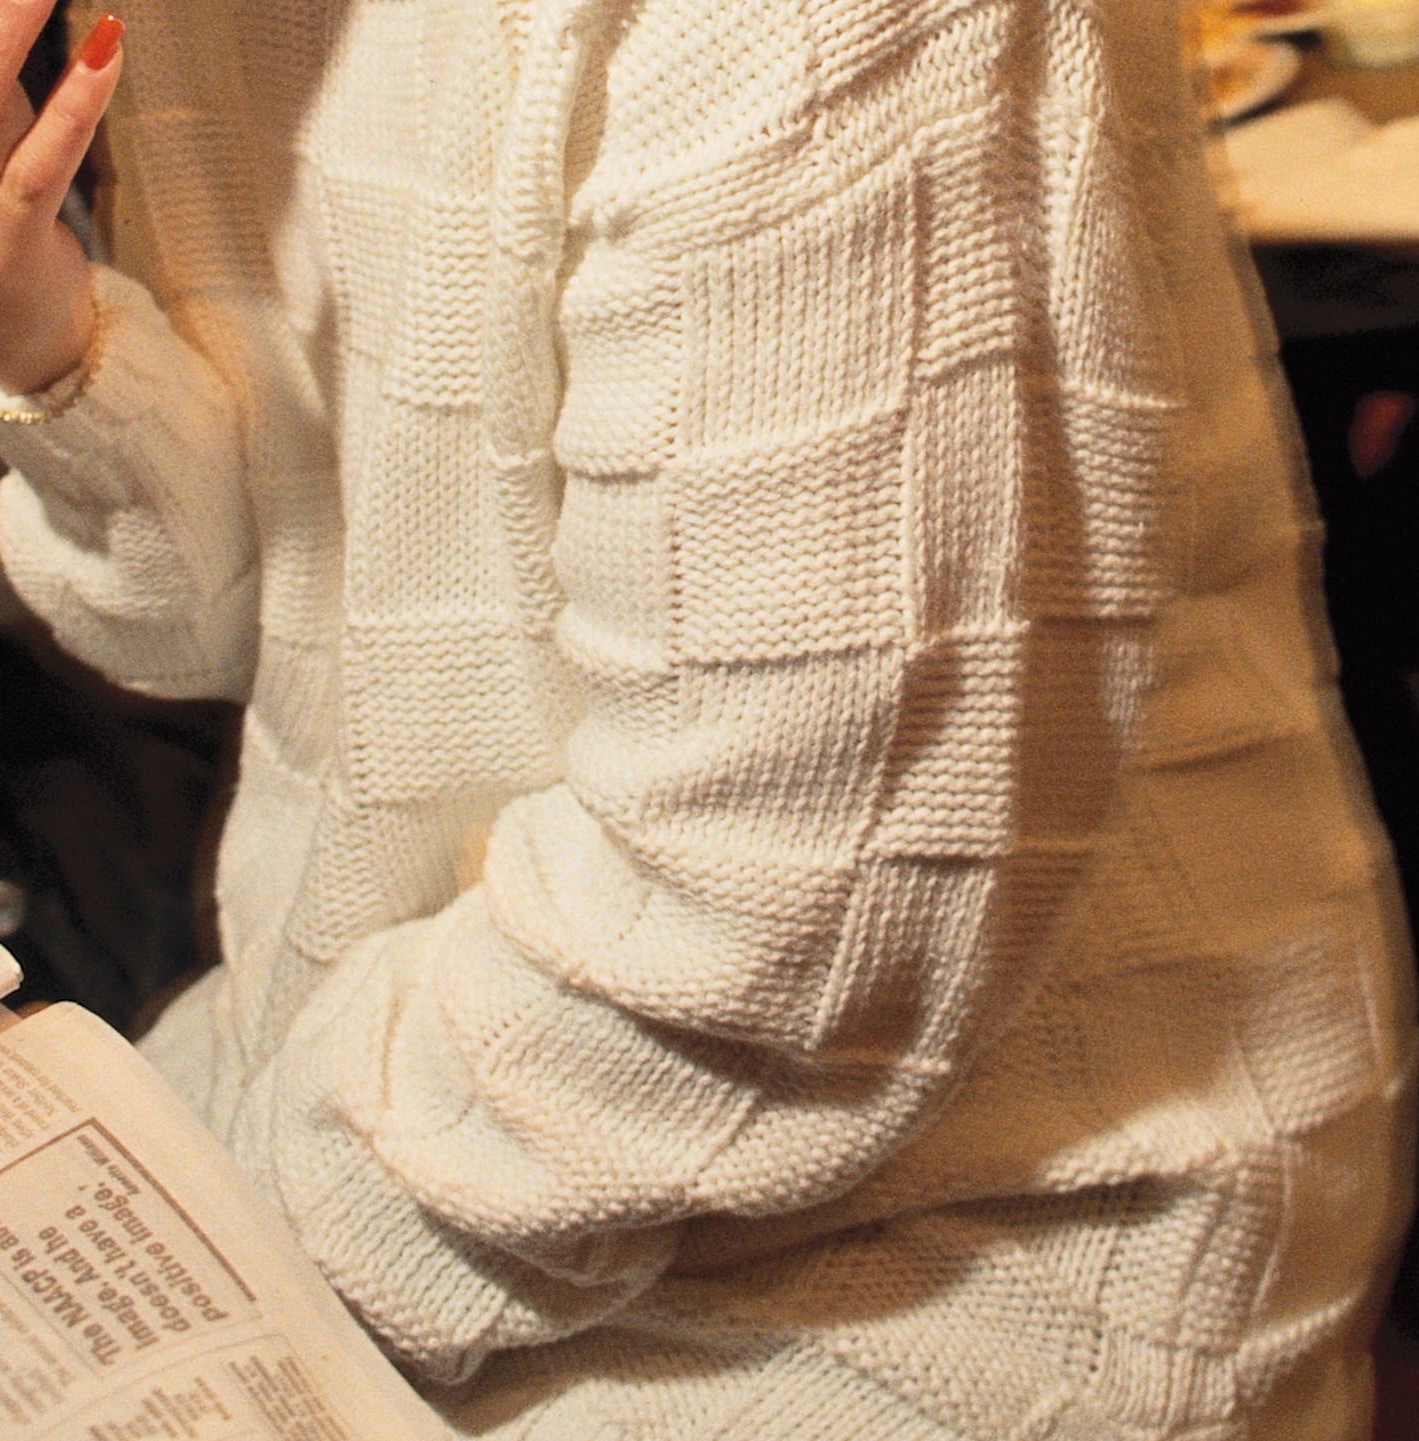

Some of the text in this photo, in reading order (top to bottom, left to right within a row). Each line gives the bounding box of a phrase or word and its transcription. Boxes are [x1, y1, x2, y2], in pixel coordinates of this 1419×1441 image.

[11, 1249, 35, 1271] is
[39, 1226, 67, 1254] he
[78, 1182, 229, 1322] positive image.'
[54, 1249, 99, 1284] And
[65, 1205, 191, 1332] doesn't have a
[21, 1270, 88, 1328] NAACP
